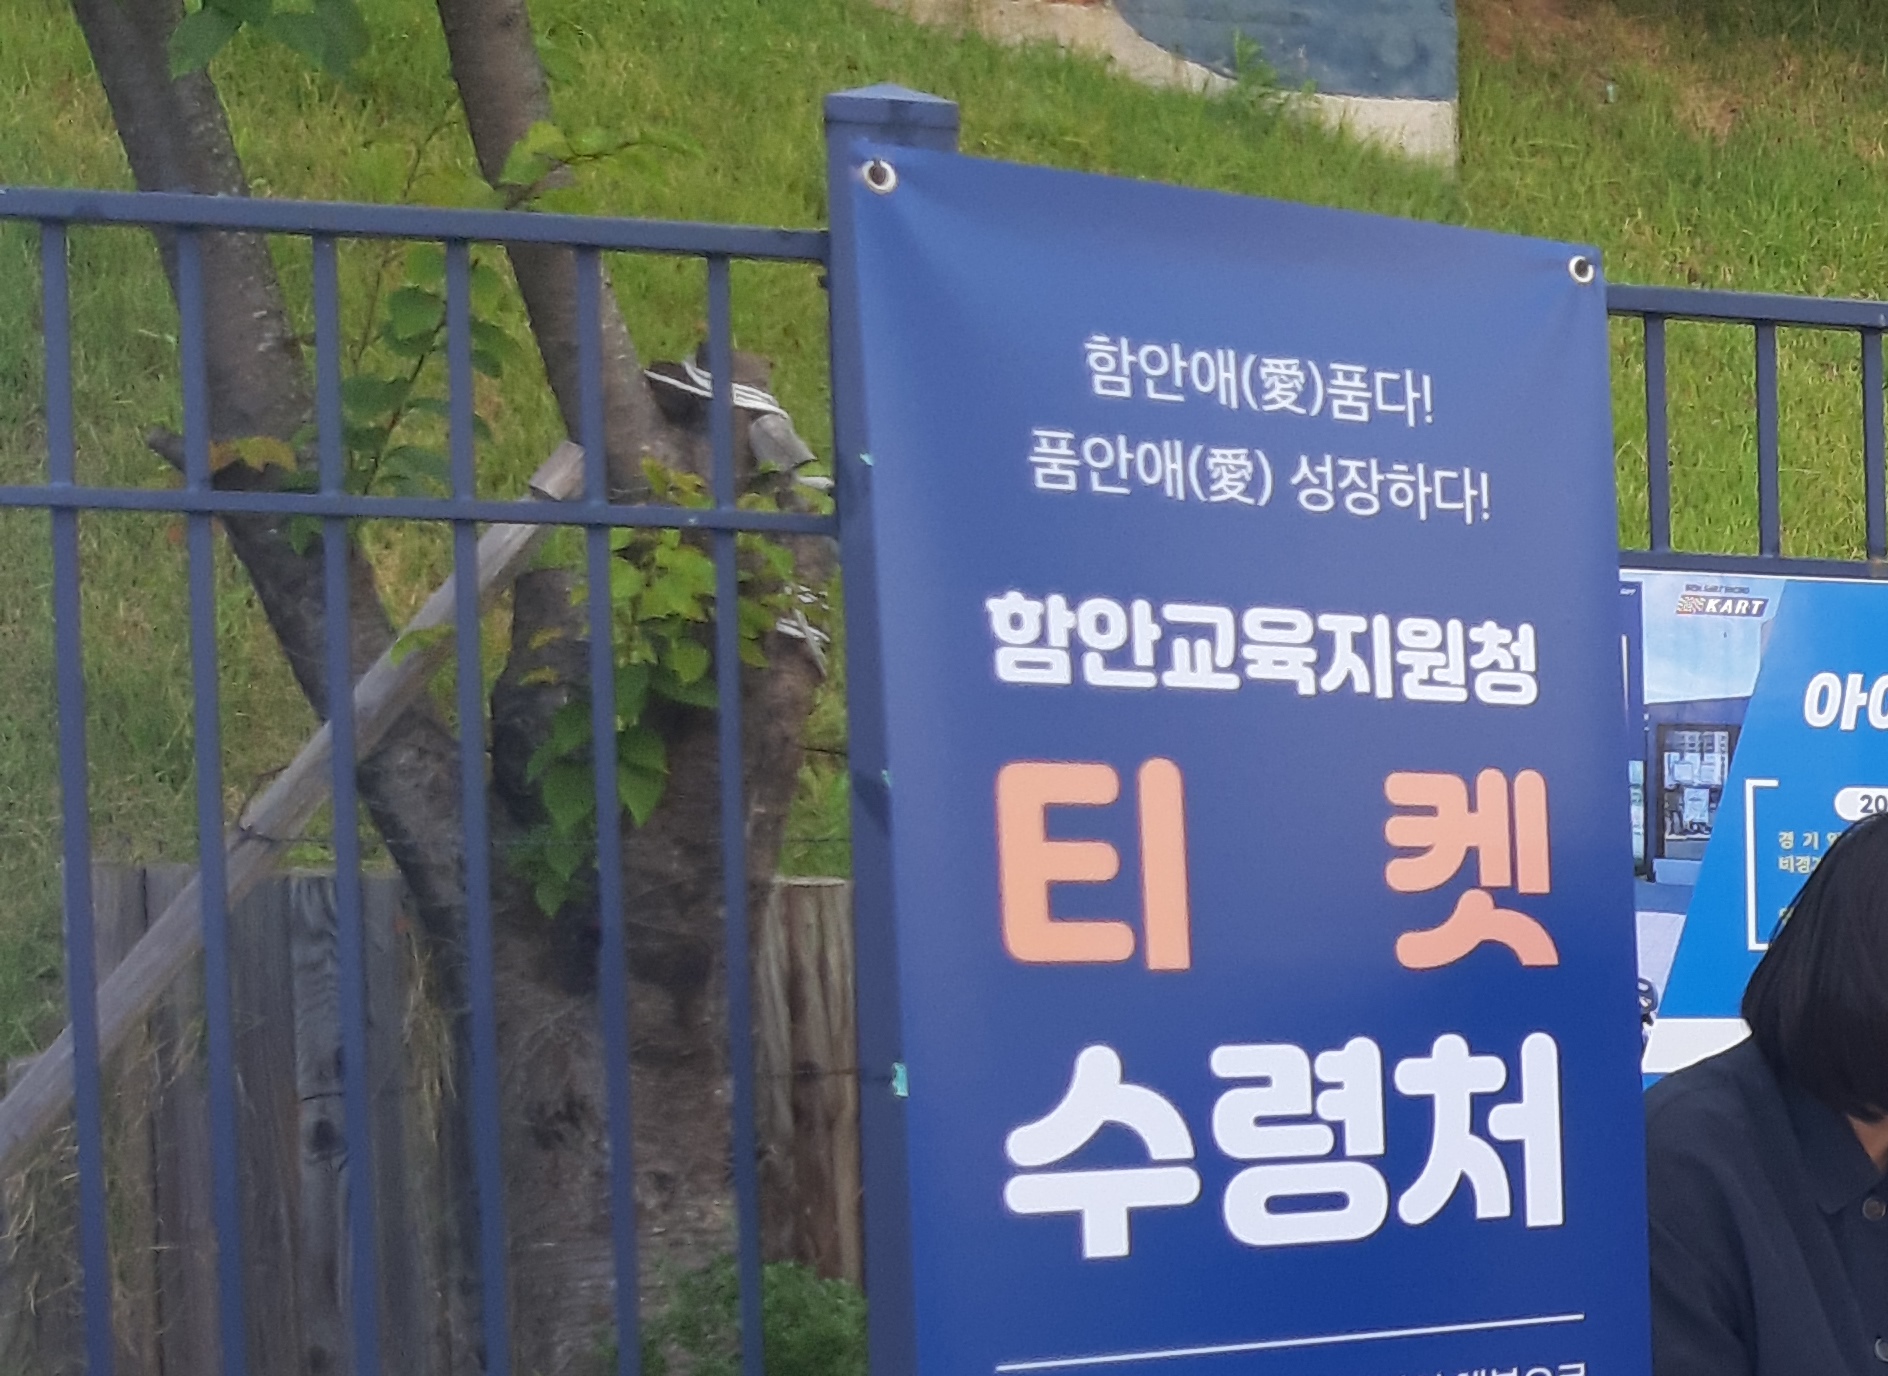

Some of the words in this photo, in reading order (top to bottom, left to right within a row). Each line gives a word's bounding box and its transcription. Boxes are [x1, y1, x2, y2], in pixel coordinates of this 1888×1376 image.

[1084, 334, 1436, 428] 함안애(愛)품다!
[1028, 428, 1273, 508] 품안애(愛)
[1290, 454, 1492, 525] 성장하다!
[985, 590, 1539, 707] 함안교육지원청
[1704, 598, 1764, 615] KART
[1003, 1031, 1564, 1260] 수령처
